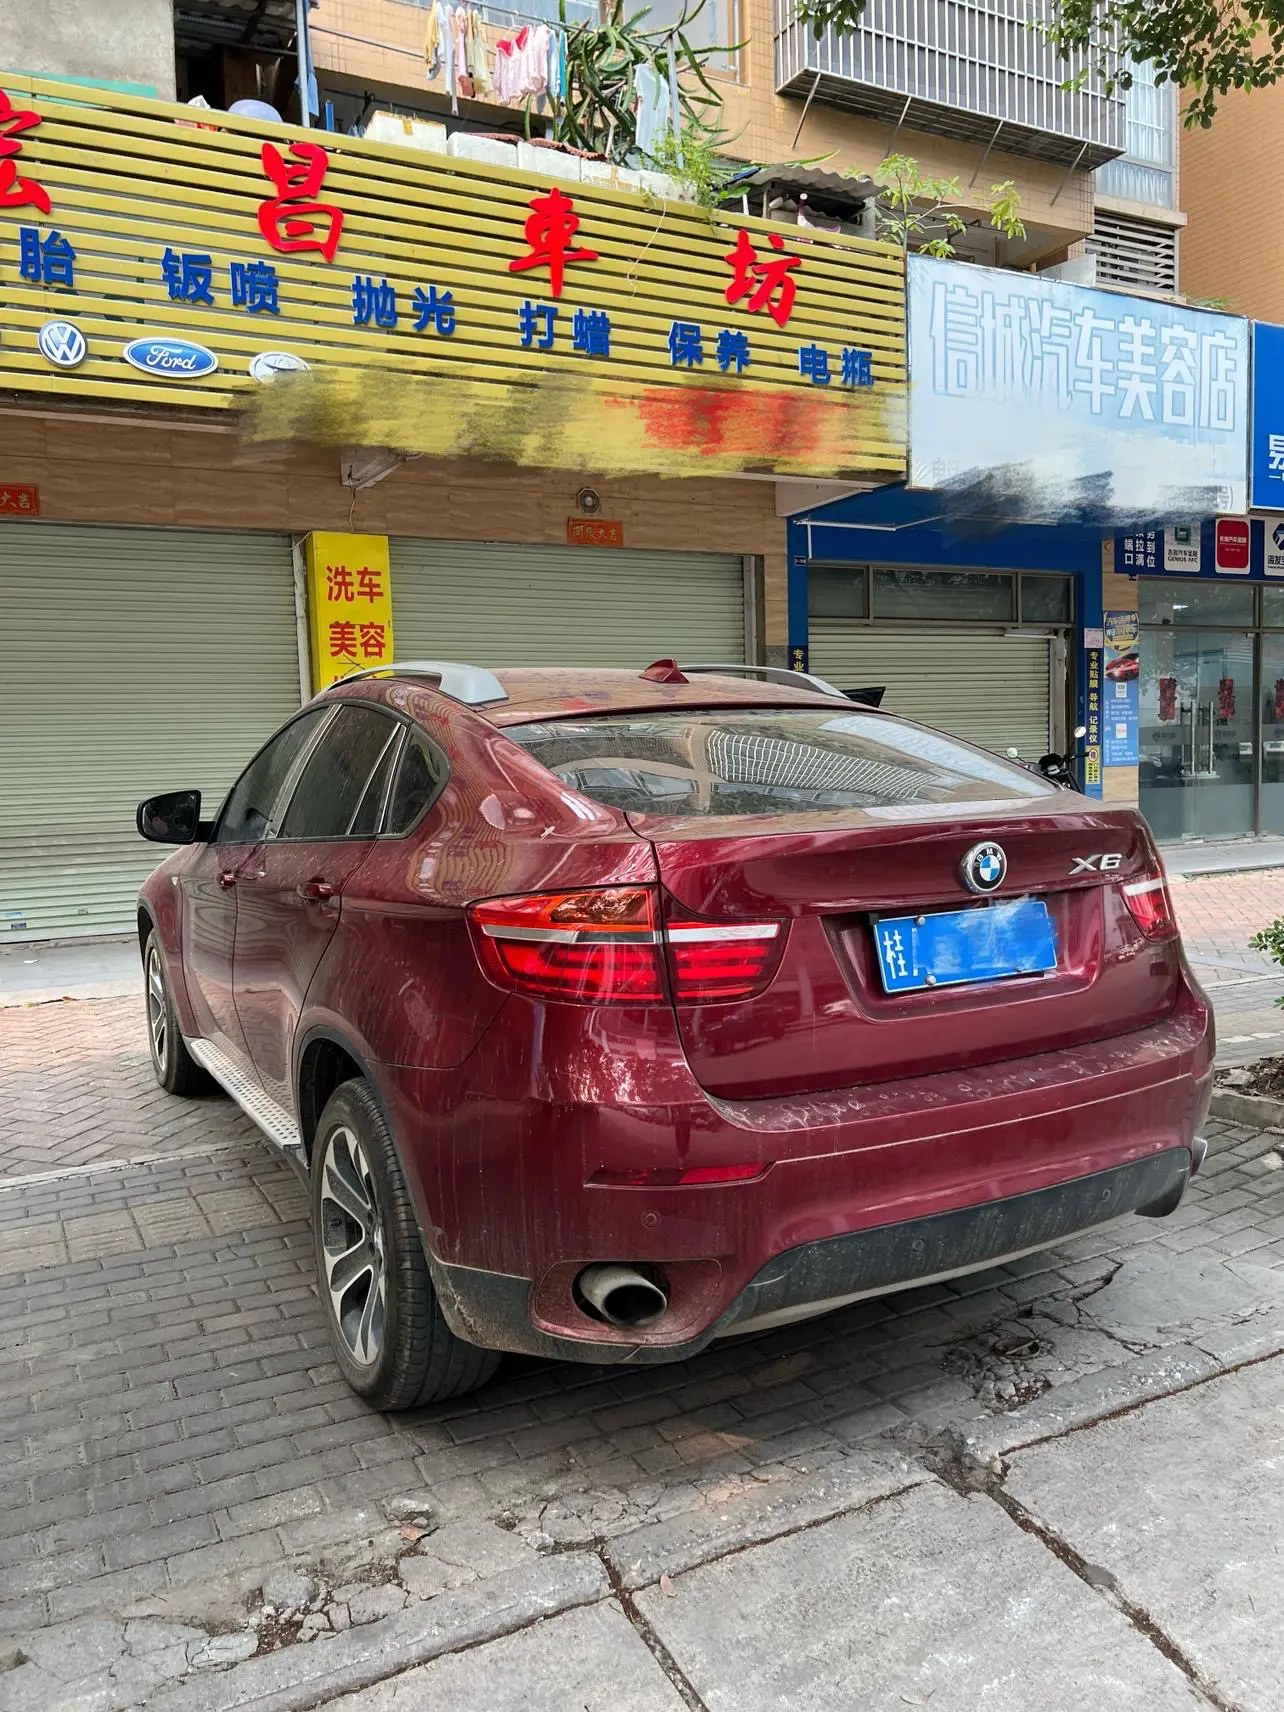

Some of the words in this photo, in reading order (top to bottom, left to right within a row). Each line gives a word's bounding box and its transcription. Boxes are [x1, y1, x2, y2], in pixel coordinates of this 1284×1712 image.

[19, 227, 76, 287] 胎
[160, 247, 281, 315] 钣喷
[351, 275, 457, 335] 抛光
[517, 300, 612, 356] 打蜡
[667, 321, 751, 373] 保养
[798, 343, 874, 387] 电瓶
[146, 345, 197, 370] Ford
[325, 565, 384, 603] 洗车
[328, 620, 386, 659] 美容
[1068, 853, 1122, 874] X6
